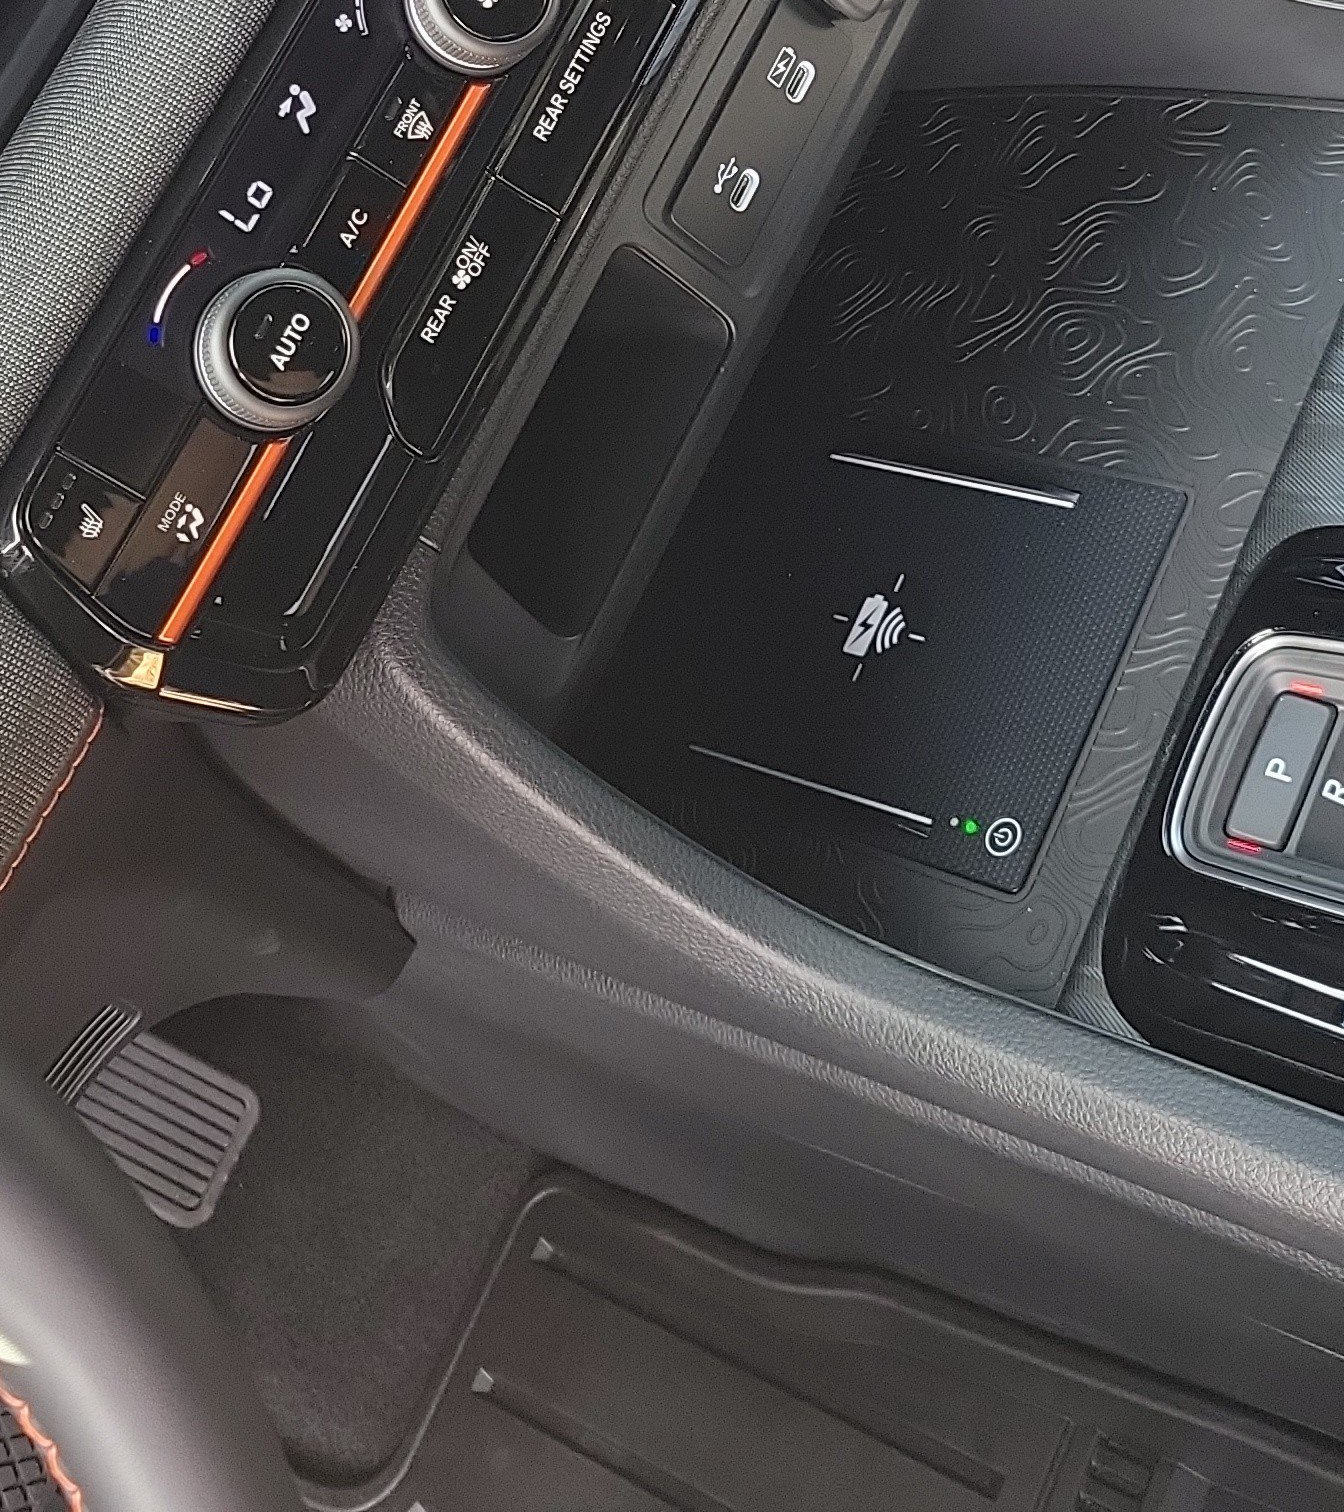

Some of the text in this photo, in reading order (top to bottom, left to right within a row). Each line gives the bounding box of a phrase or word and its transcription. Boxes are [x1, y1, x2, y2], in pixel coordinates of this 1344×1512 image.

[533, 10, 612, 143] REAR SETTINGS
[394, 98, 422, 140] FRONT
[339, 208, 369, 248] A/C
[467, 241, 492, 279] OFF
[420, 235, 481, 345] REAR ON/
[270, 313, 311, 371] AUTO
[158, 491, 187, 535] MODE
[1265, 756, 1294, 784] P
